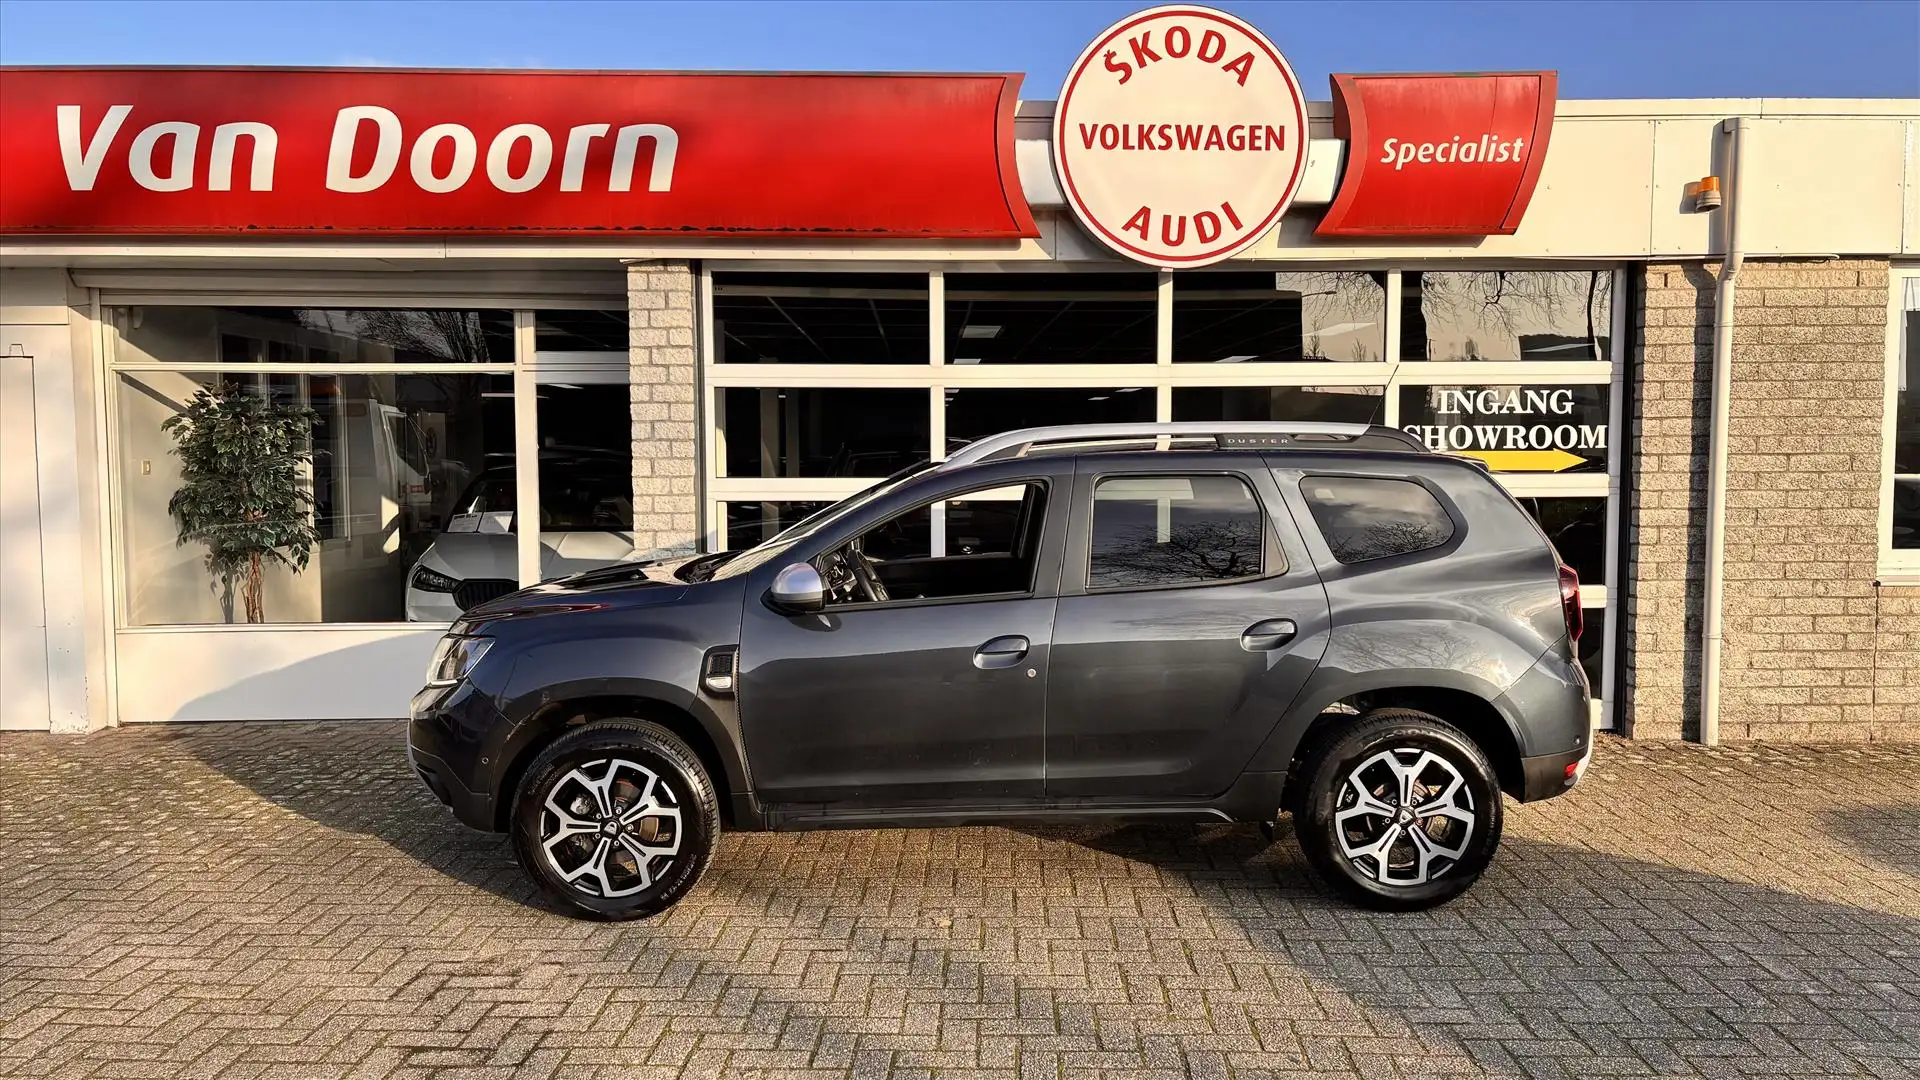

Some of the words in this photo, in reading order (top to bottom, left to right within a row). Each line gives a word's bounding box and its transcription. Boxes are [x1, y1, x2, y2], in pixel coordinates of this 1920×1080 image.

[1103, 25, 1256, 87] ŠKODA
[56, 104, 278, 192] Van
[325, 105, 679, 193] Doorn
[1078, 122, 1286, 151] VOLKSWAGEN
[1380, 133, 1525, 171] Specialist
[1121, 201, 1244, 247] AUDI
[1437, 389, 1575, 415] INGANG
[1227, 437, 1289, 445] DUSTER
